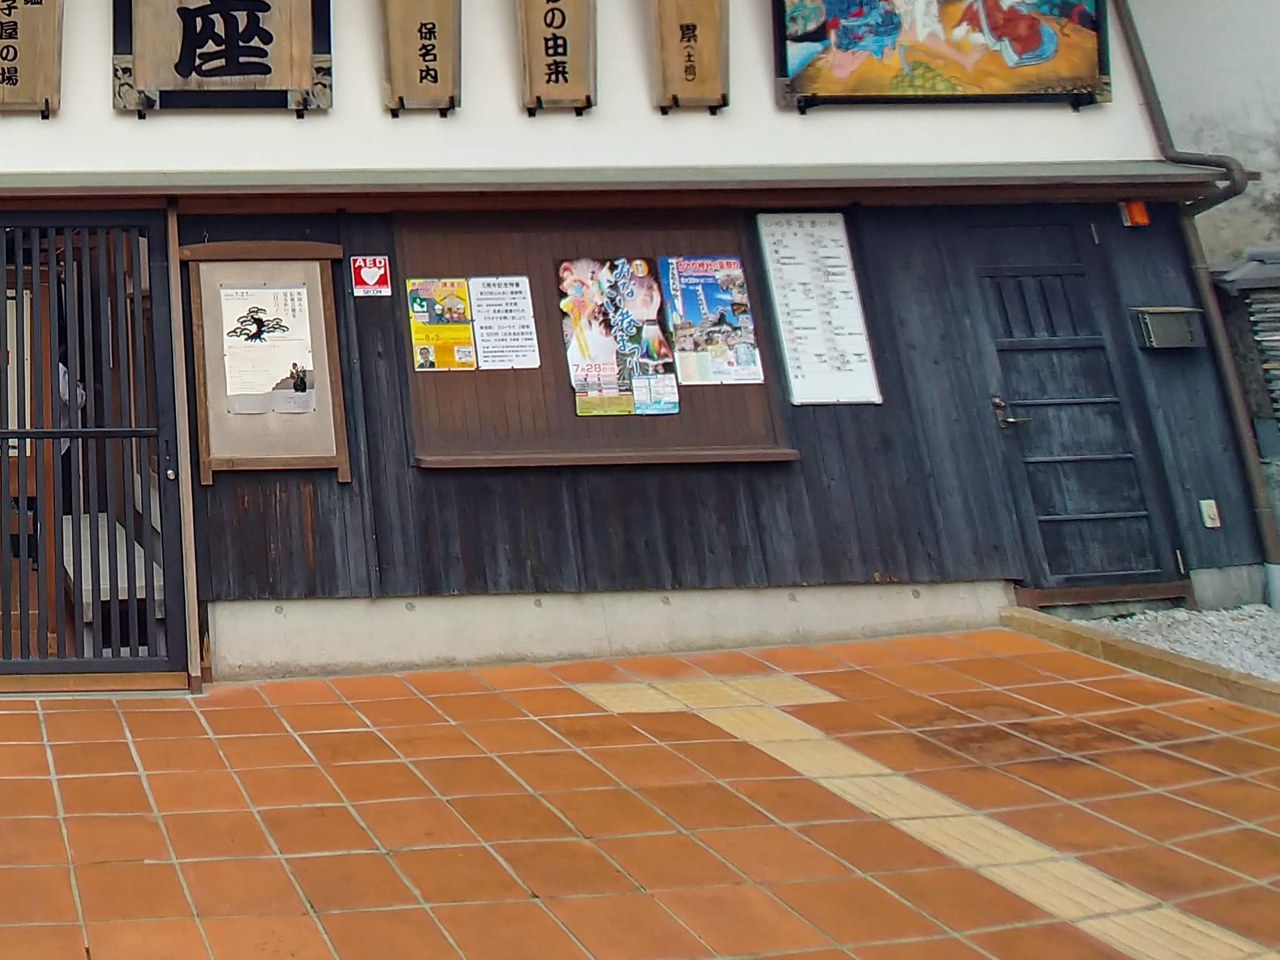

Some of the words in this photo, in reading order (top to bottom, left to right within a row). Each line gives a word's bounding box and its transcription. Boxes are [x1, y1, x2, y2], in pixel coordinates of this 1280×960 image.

[416, 21, 439, 84] 保名内
[355, 258, 385, 268] AED
